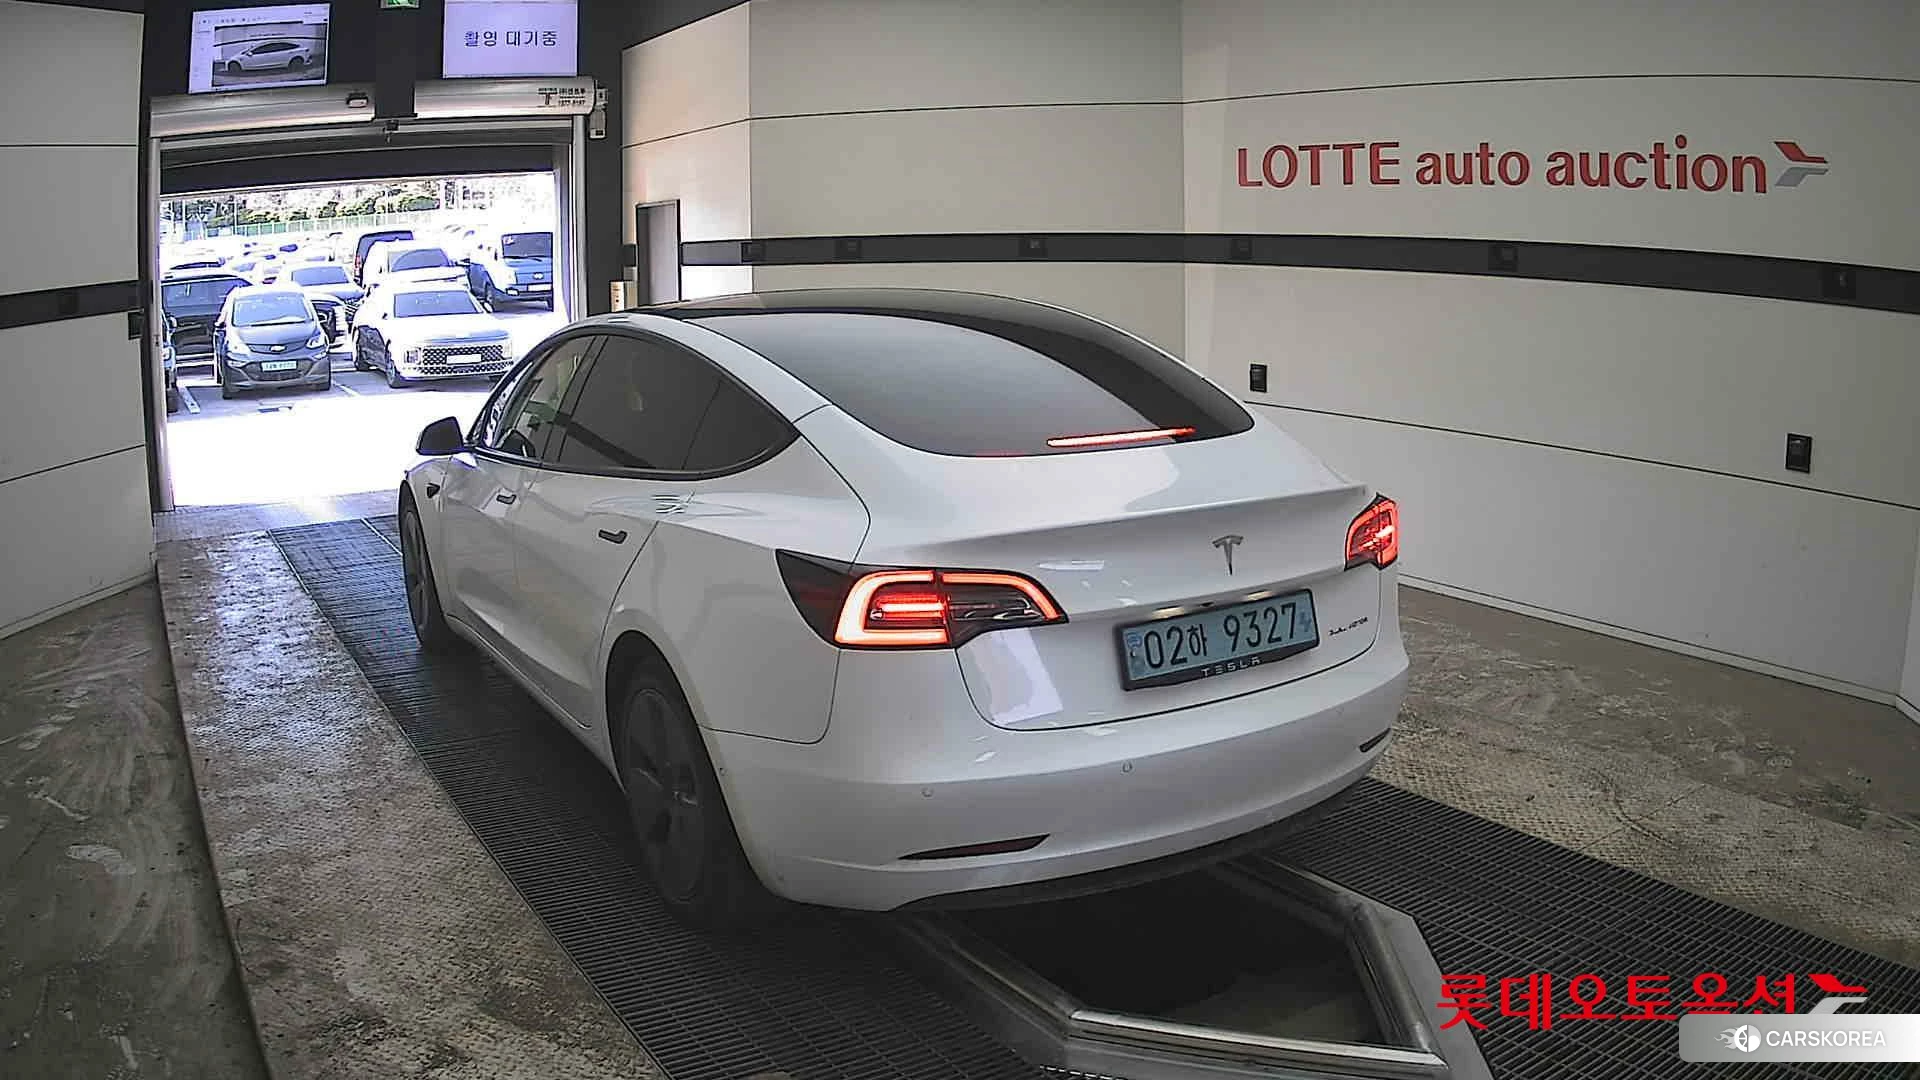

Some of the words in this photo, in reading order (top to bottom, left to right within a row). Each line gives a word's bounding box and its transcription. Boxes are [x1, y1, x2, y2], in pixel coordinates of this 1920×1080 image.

[505, 30, 557, 47] 대기중
[1236, 141, 1400, 188] LOTTE
[1415, 142, 1530, 187] auto
[1545, 134, 1768, 194] auction
[1143, 623, 1208, 669] 02하
[1223, 602, 1296, 652] 9327
[1200, 655, 1261, 678] TESLA
